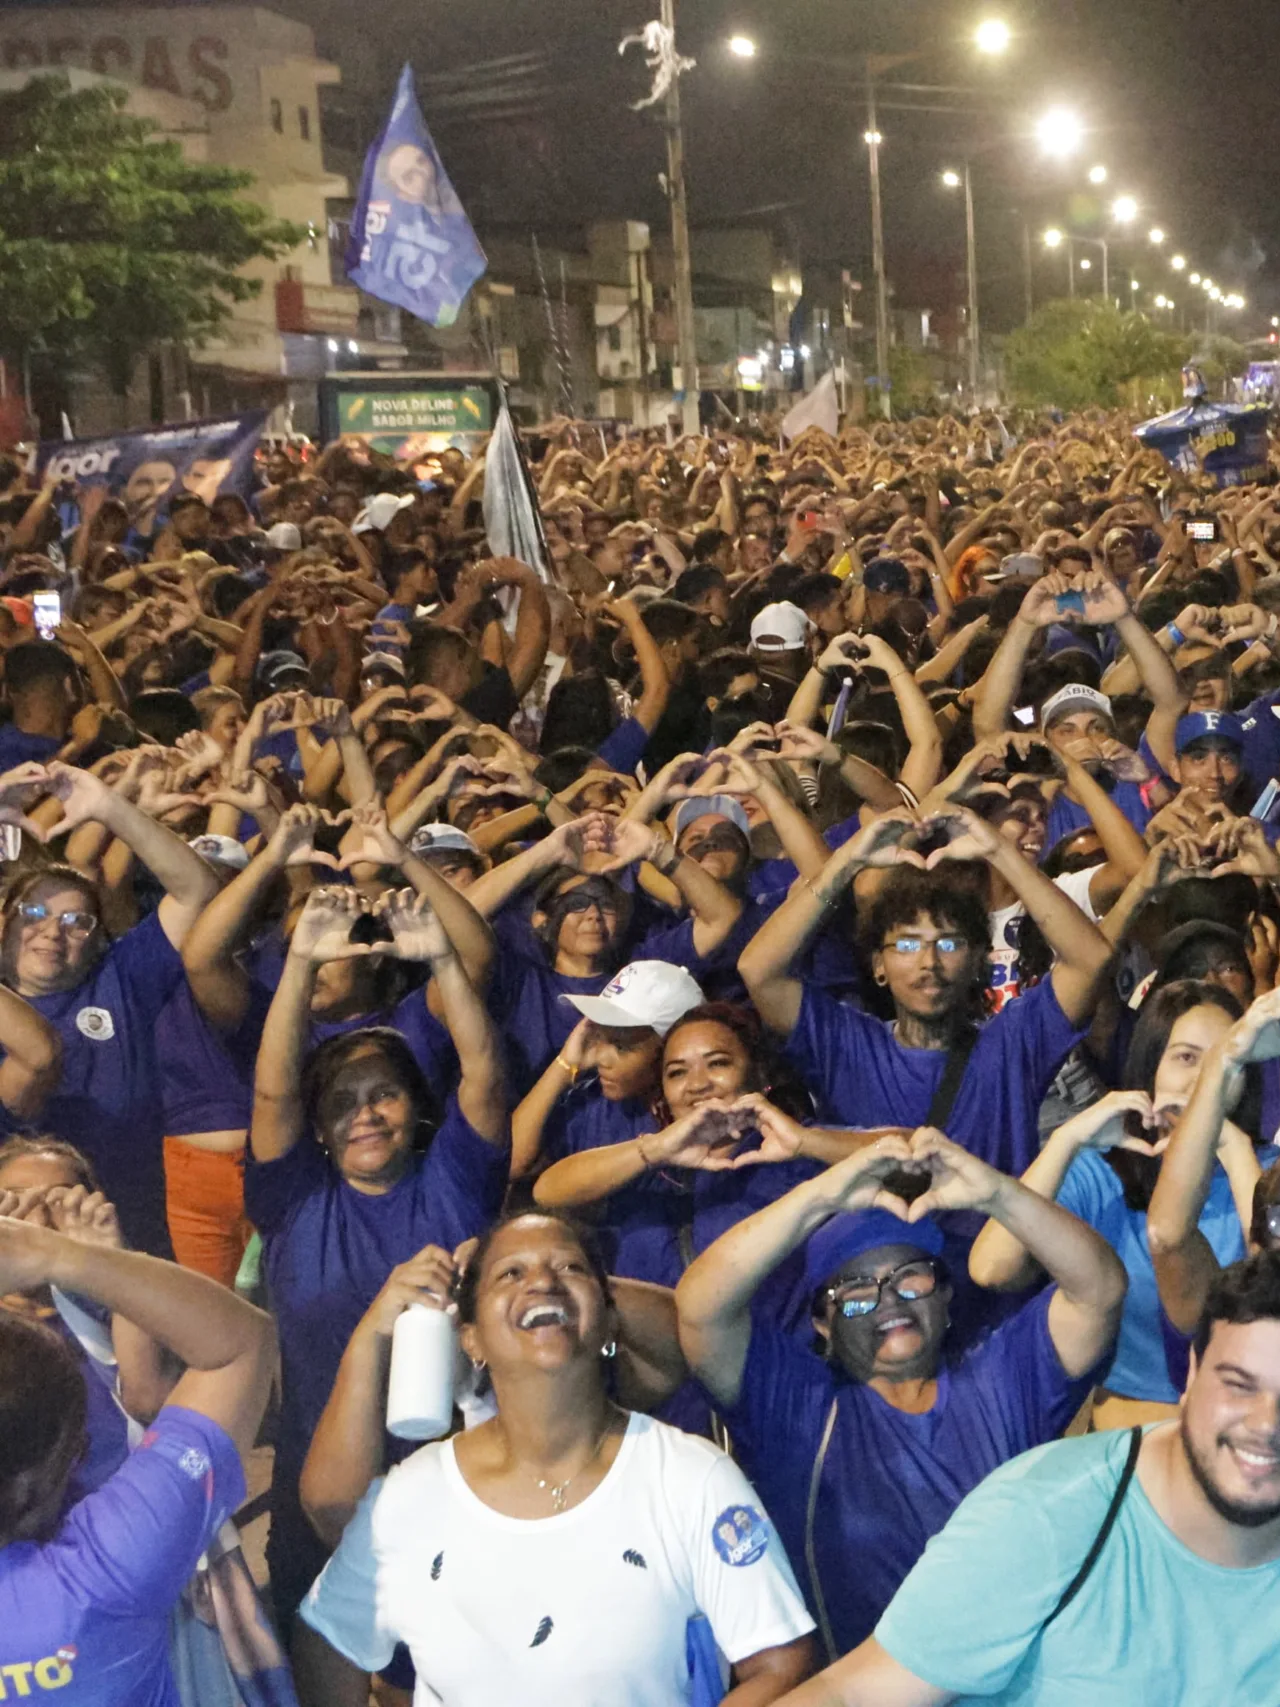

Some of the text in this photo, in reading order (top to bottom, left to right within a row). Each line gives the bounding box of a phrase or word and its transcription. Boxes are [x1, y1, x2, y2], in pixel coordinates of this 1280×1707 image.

[371, 399, 408, 412] NOVA
[371, 414, 456, 427] SABOR MILHO
[1205, 712, 1221, 730] F
